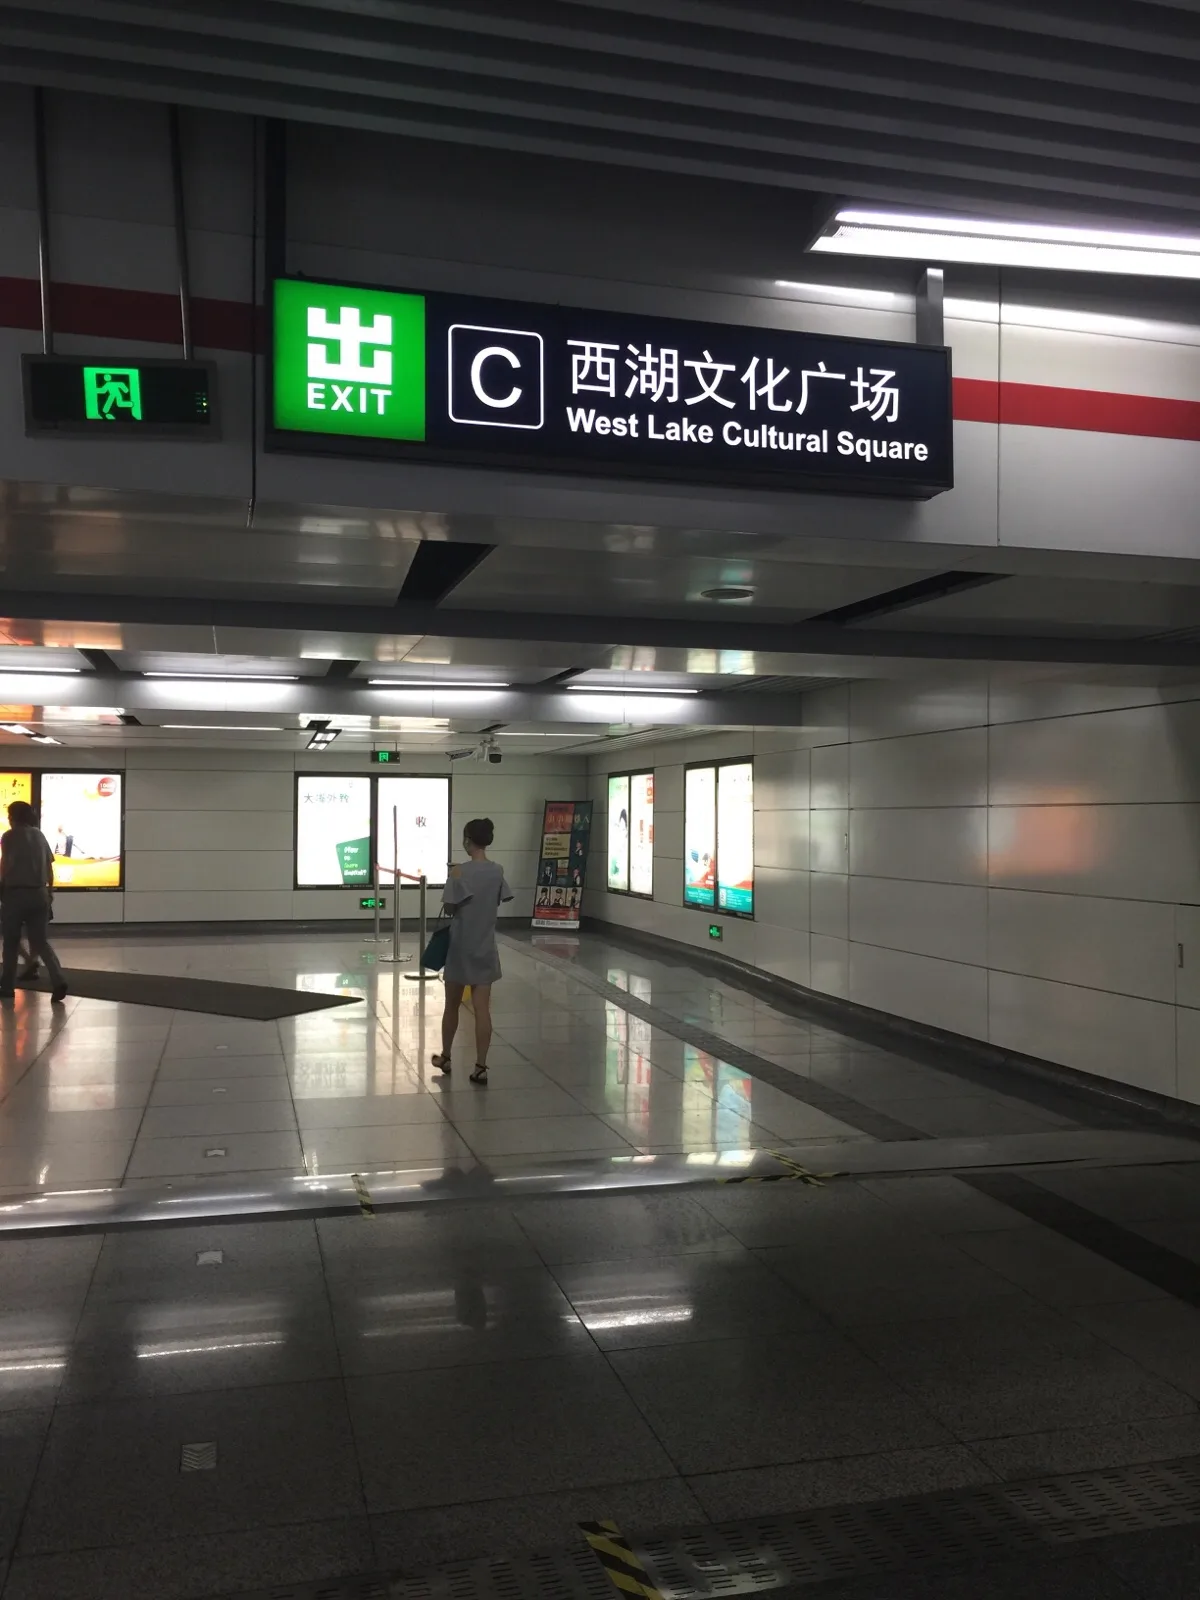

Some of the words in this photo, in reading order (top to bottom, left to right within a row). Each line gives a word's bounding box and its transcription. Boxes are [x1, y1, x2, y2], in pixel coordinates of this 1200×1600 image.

[307, 382, 392, 415] EXIT
[470, 346, 523, 408] C
[566, 339, 900, 423] 西湖文化广场
[566, 406, 639, 438] West
[648, 415, 714, 443] Lake
[722, 421, 828, 453] Cultural
[836, 430, 929, 463] Square
